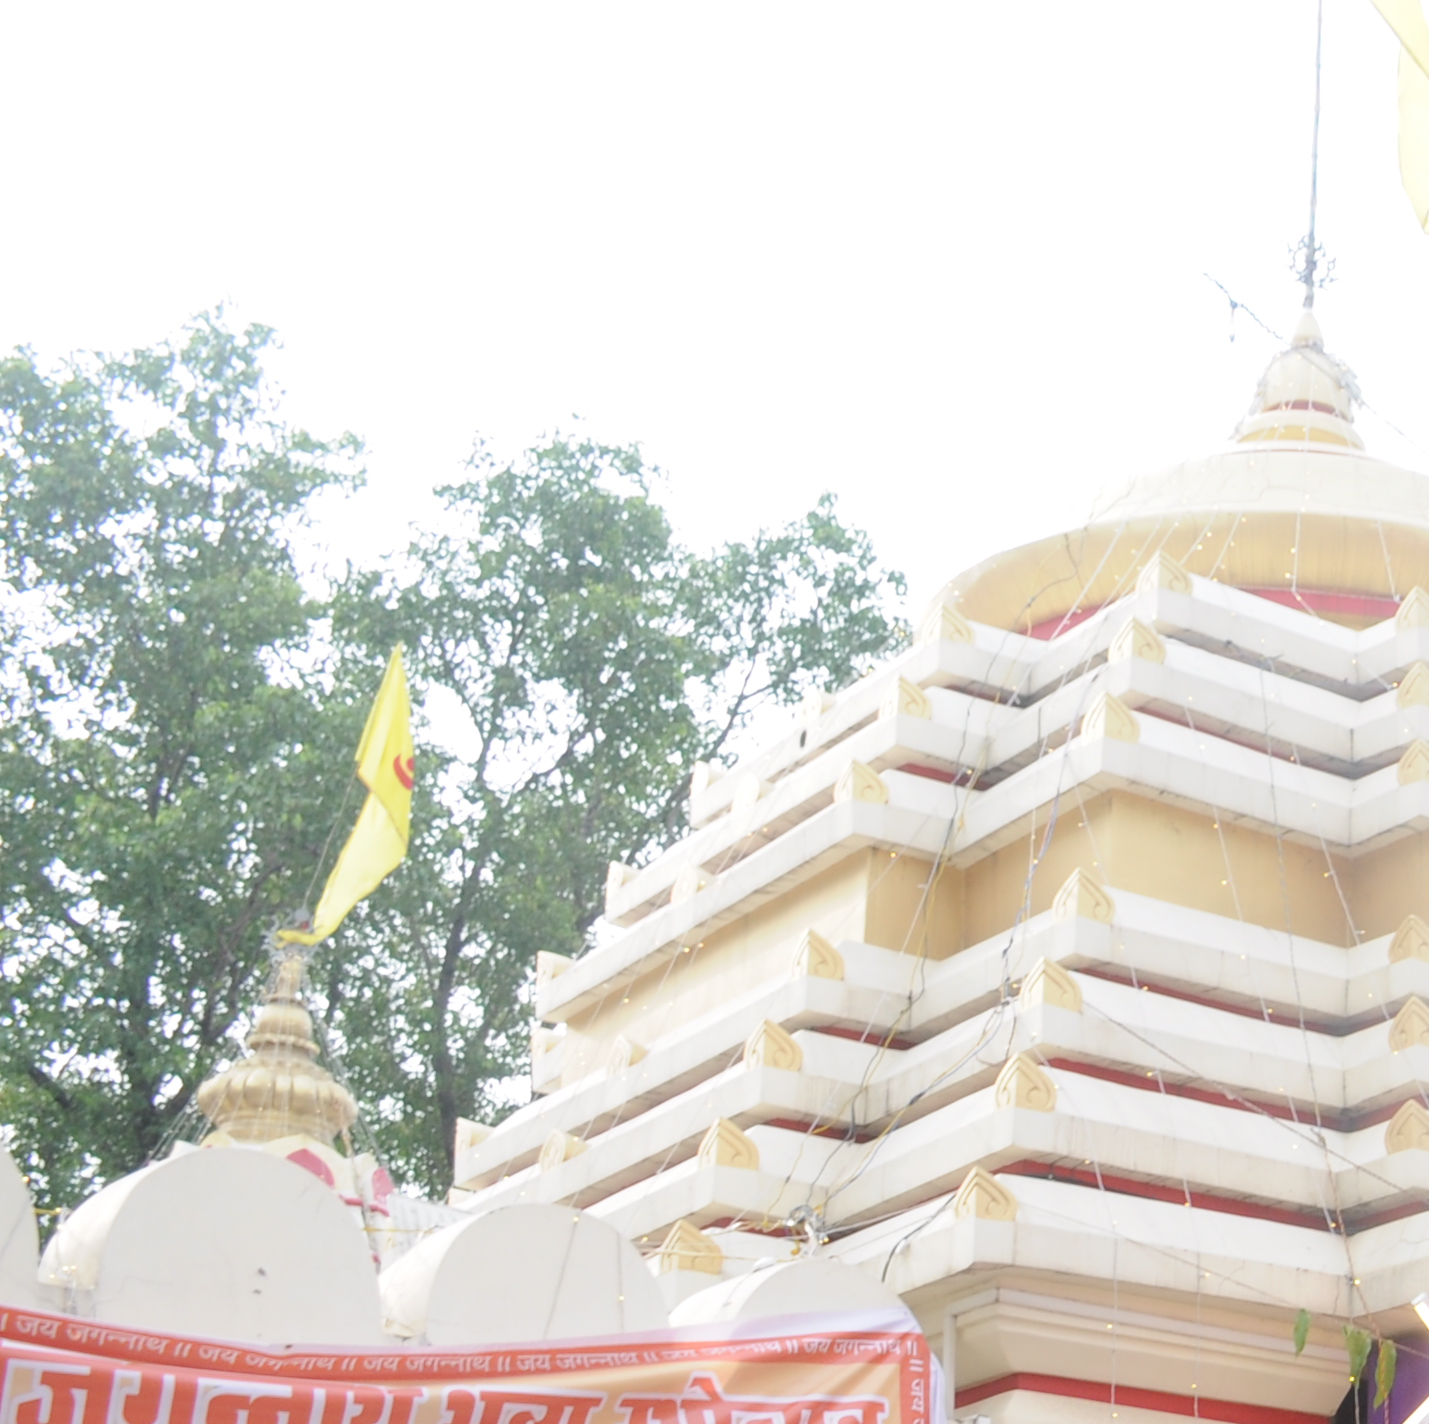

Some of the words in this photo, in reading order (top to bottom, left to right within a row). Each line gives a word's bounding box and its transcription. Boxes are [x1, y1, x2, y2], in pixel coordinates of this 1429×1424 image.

[16, 1315, 62, 1338] जय
[66, 1322, 170, 1355] जगन्नाथ
[197, 1343, 241, 1365] जय
[363, 1356, 401, 1371] जय
[405, 1354, 493, 1373] जगन्नाथ
[516, 1353, 551, 1373] जय
[556, 1351, 639, 1371] जगन्नाथ
[801, 1337, 833, 1355] जय
[833, 1337, 902, 1356] जगन्नाथ
